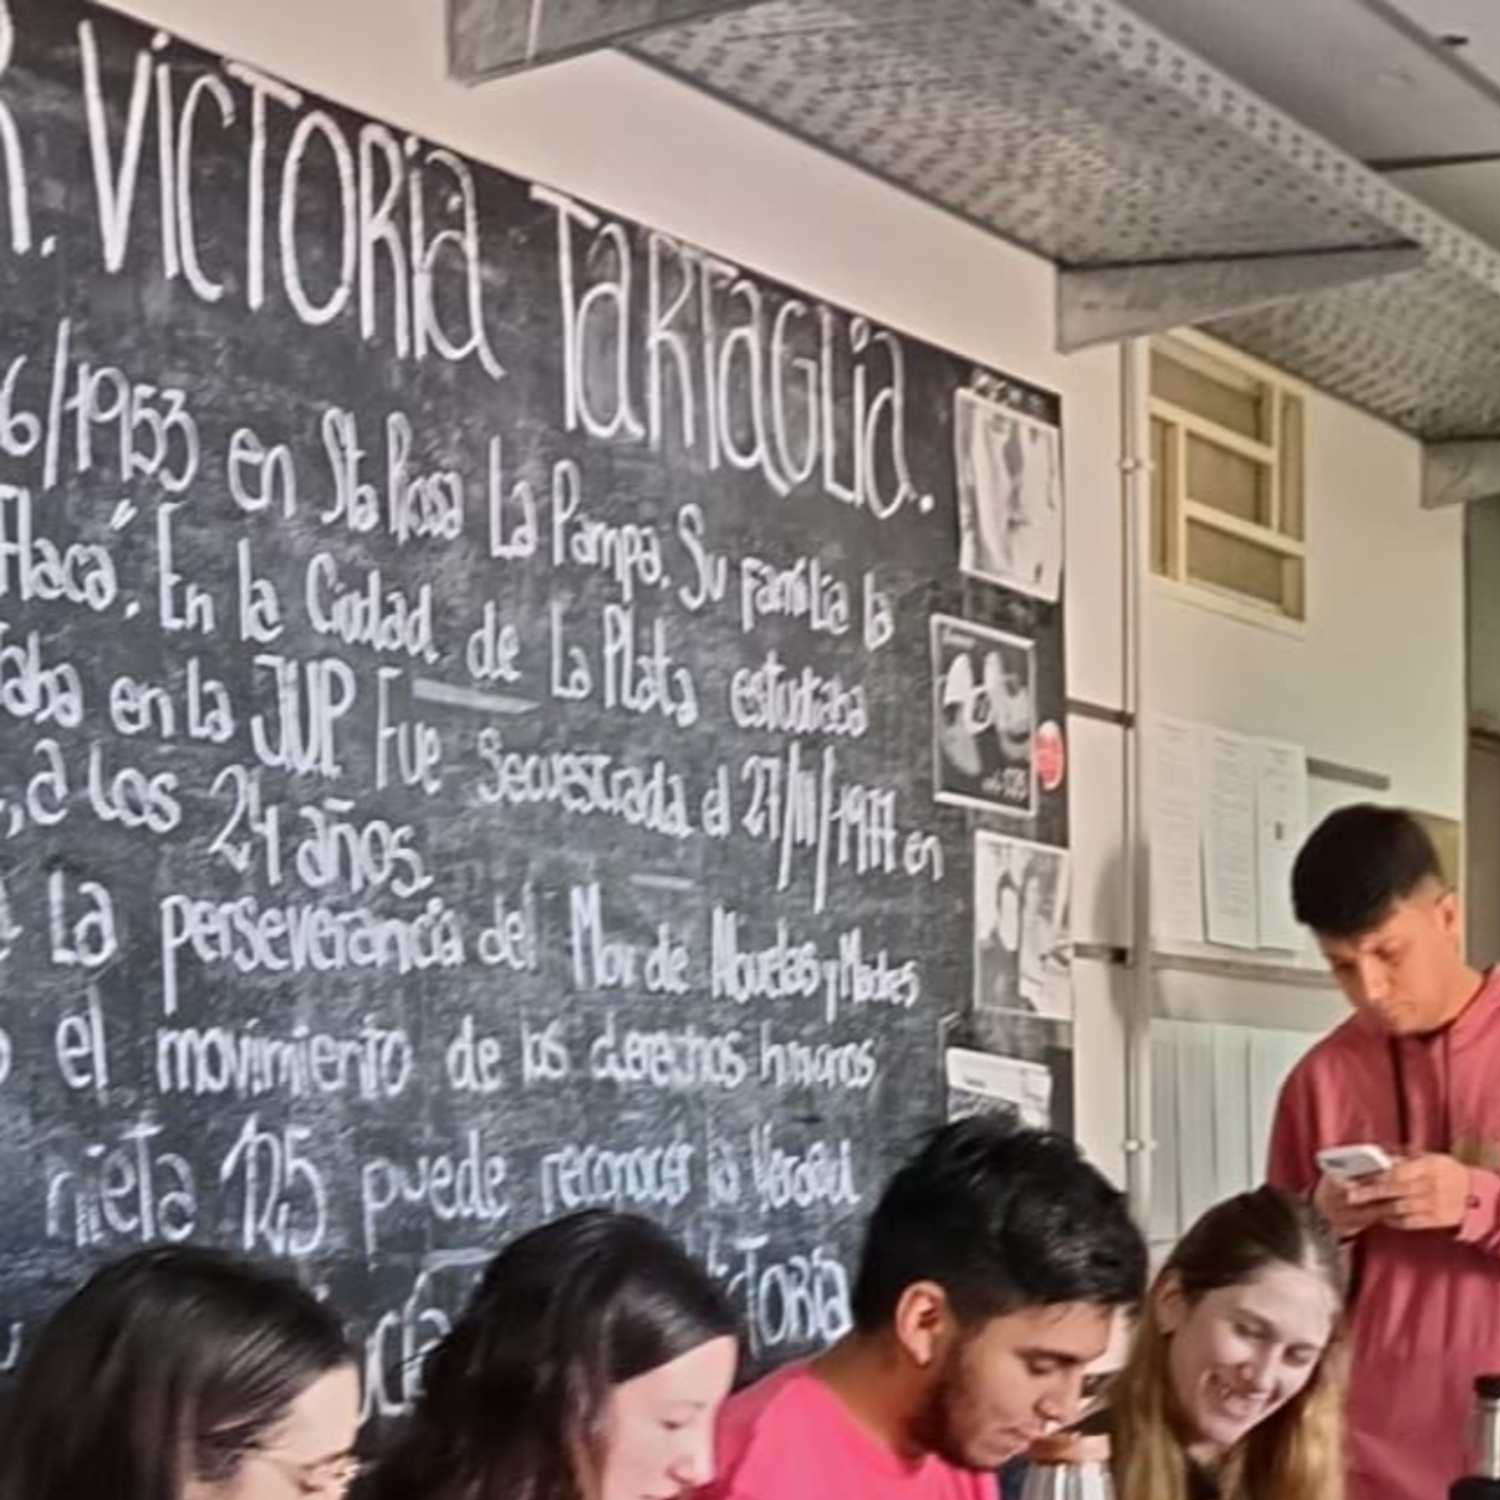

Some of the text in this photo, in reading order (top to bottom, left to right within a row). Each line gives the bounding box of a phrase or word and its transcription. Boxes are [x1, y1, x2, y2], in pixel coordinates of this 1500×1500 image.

[228, 427, 297, 518] en
[678, 503, 727, 610] Su
[110, 676, 175, 738] en
[446, 1014, 502, 1093] de
